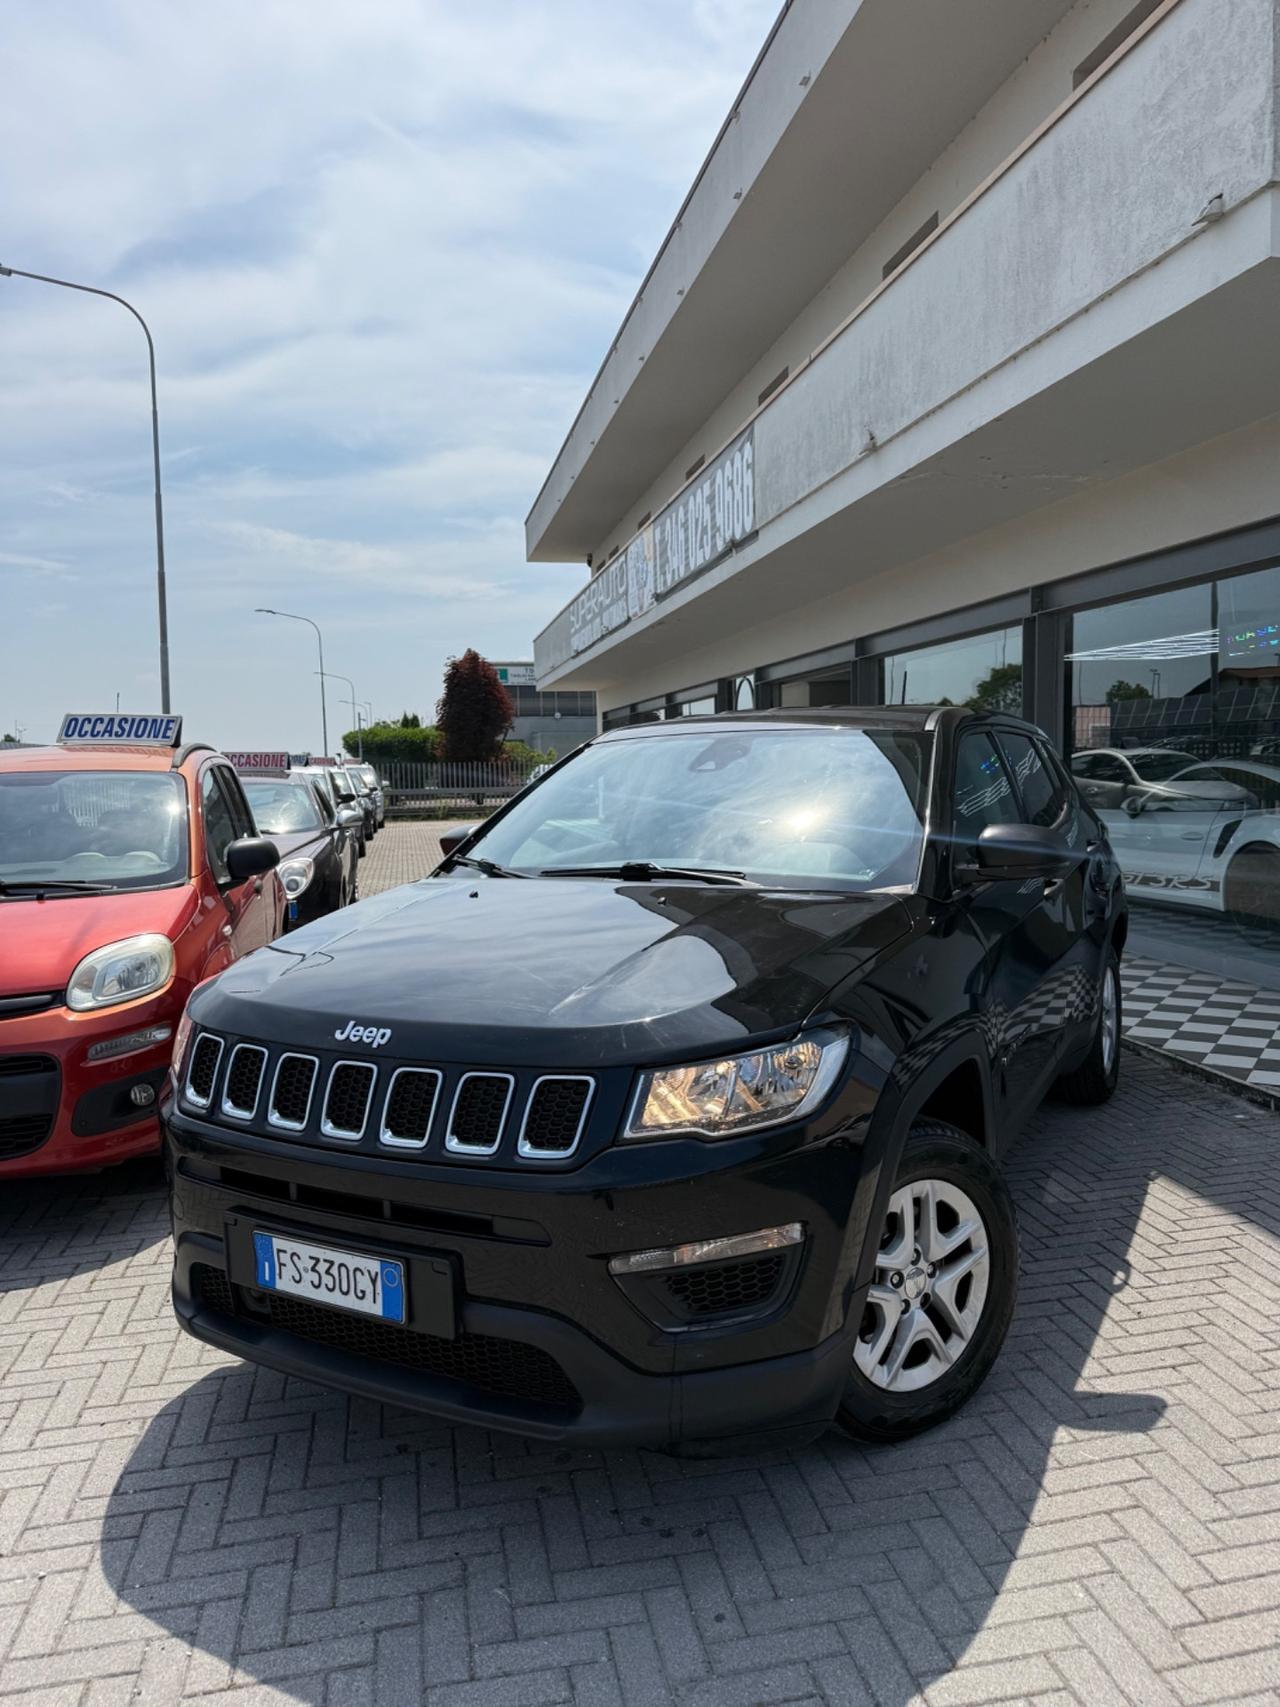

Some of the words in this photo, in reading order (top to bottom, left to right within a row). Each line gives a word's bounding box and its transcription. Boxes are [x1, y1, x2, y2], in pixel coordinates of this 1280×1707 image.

[665, 504, 685, 586] 346
[688, 479, 711, 571] 025
[715, 441, 753, 551] 9686
[64, 717, 175, 739] OCCASIONE
[224, 754, 286, 767] CCASIONE
[334, 1020, 392, 1048] Jeep
